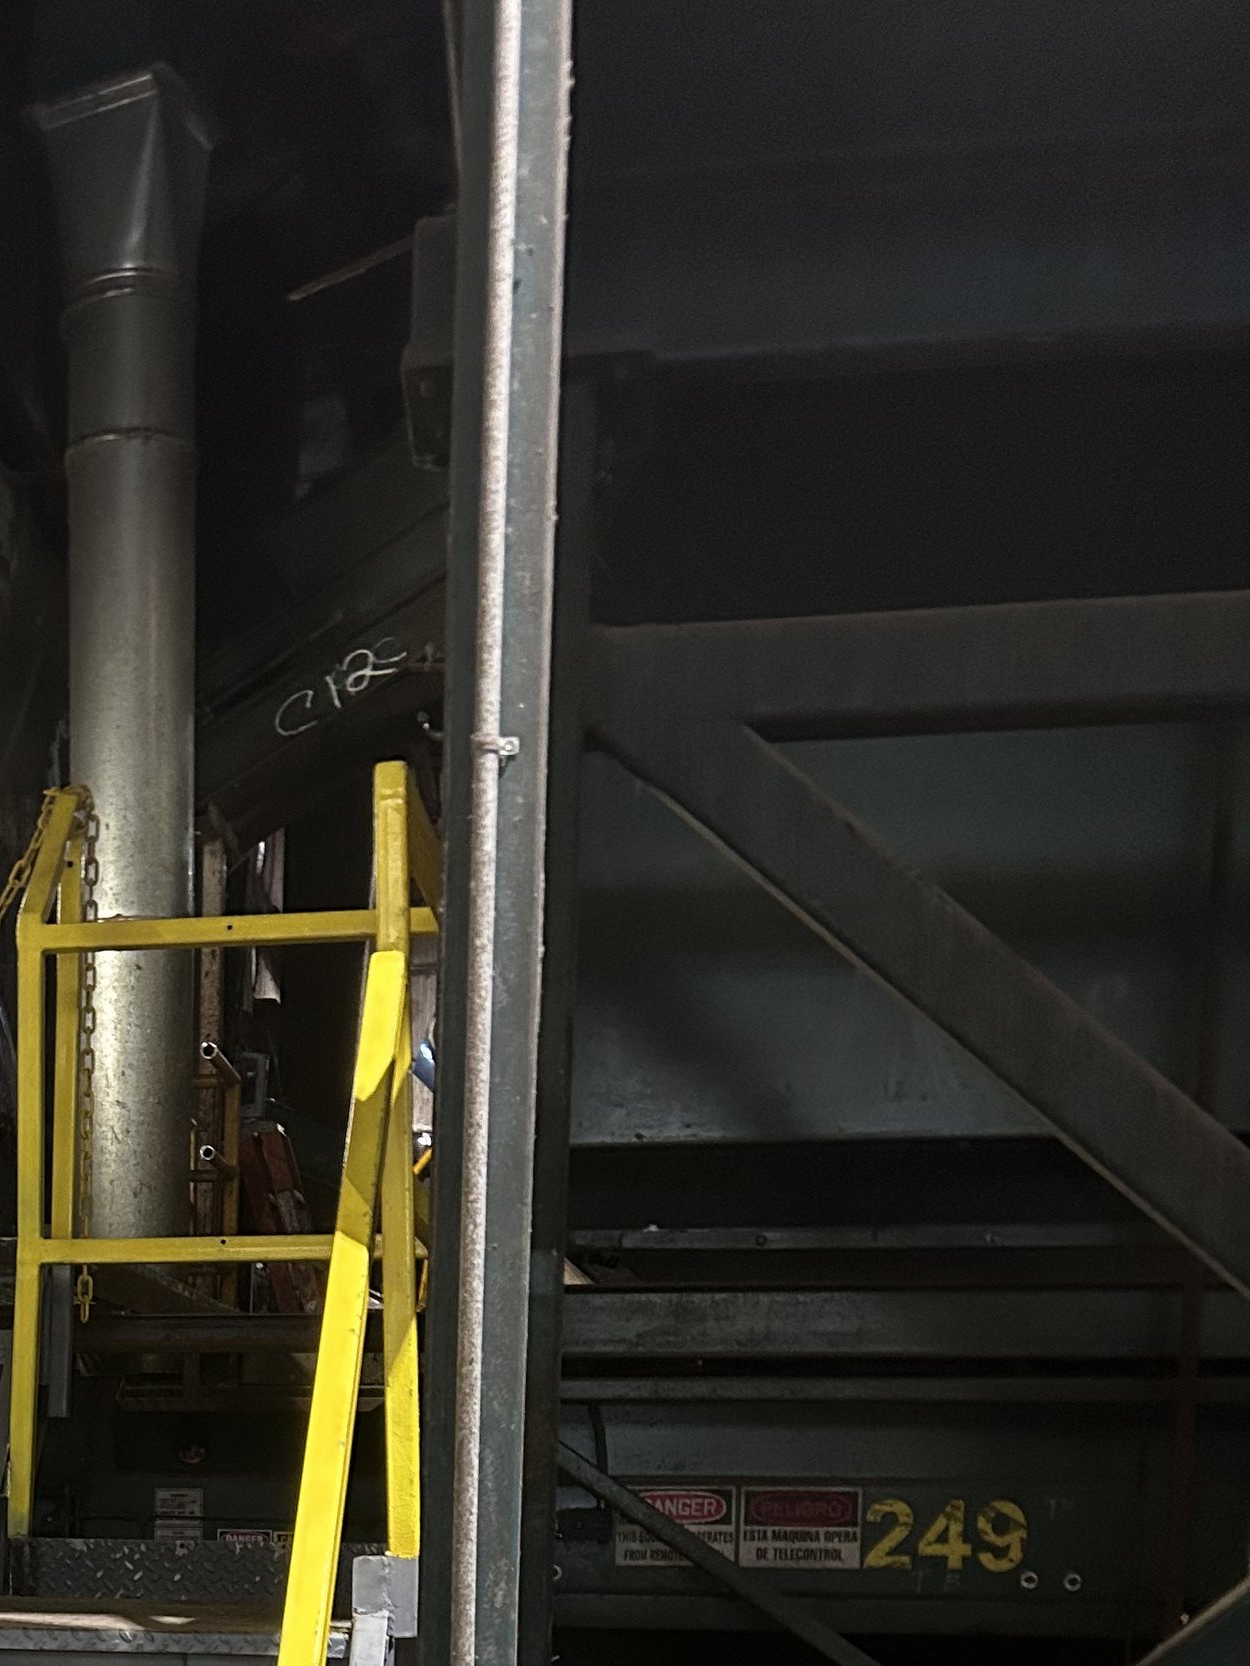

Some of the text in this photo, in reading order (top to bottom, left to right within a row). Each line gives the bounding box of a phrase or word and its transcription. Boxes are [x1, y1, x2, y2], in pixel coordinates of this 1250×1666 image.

[760, 1501, 843, 1518] PELIGRO
[743, 1530, 768, 1542] ESTA
[862, 1498, 1029, 1573] 249
[756, 1548, 844, 1562] DE TELECONTROL
